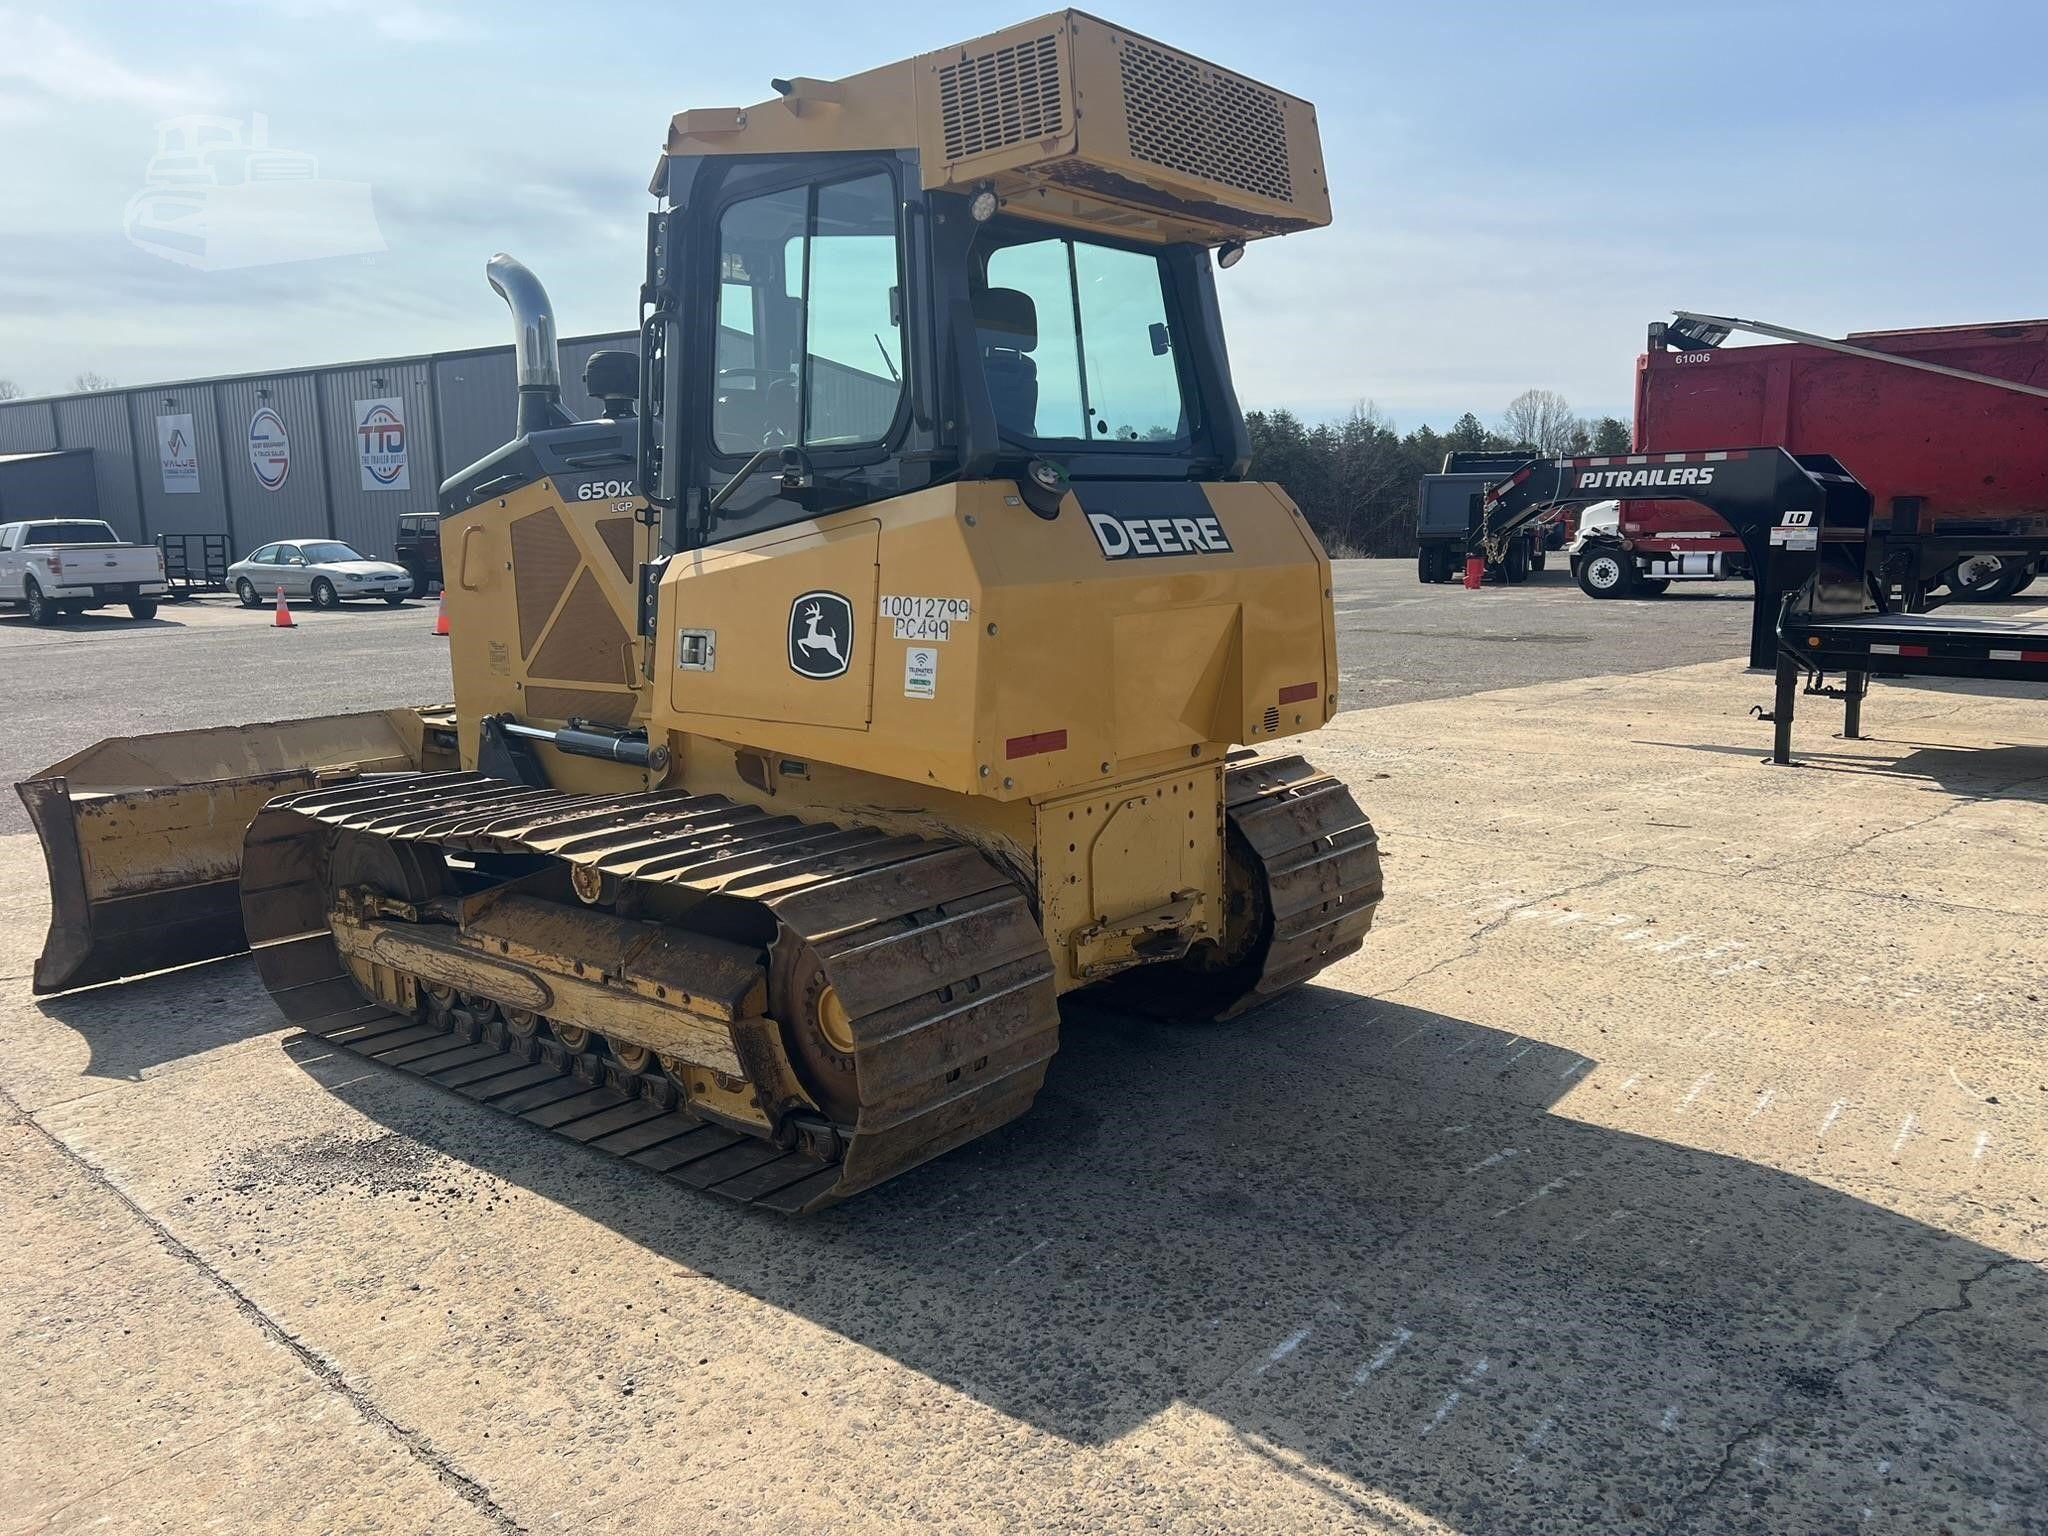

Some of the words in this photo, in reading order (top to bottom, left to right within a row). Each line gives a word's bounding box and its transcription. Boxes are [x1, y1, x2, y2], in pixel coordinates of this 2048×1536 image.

[1675, 353, 1711, 364] 61006
[163, 459, 195, 468] VALUE
[577, 480, 633, 500] 650K
[611, 501, 633, 513] LGP
[1788, 513, 1806, 524] LD
[881, 596, 969, 620] 10012799
[895, 617, 949, 640] PC499
